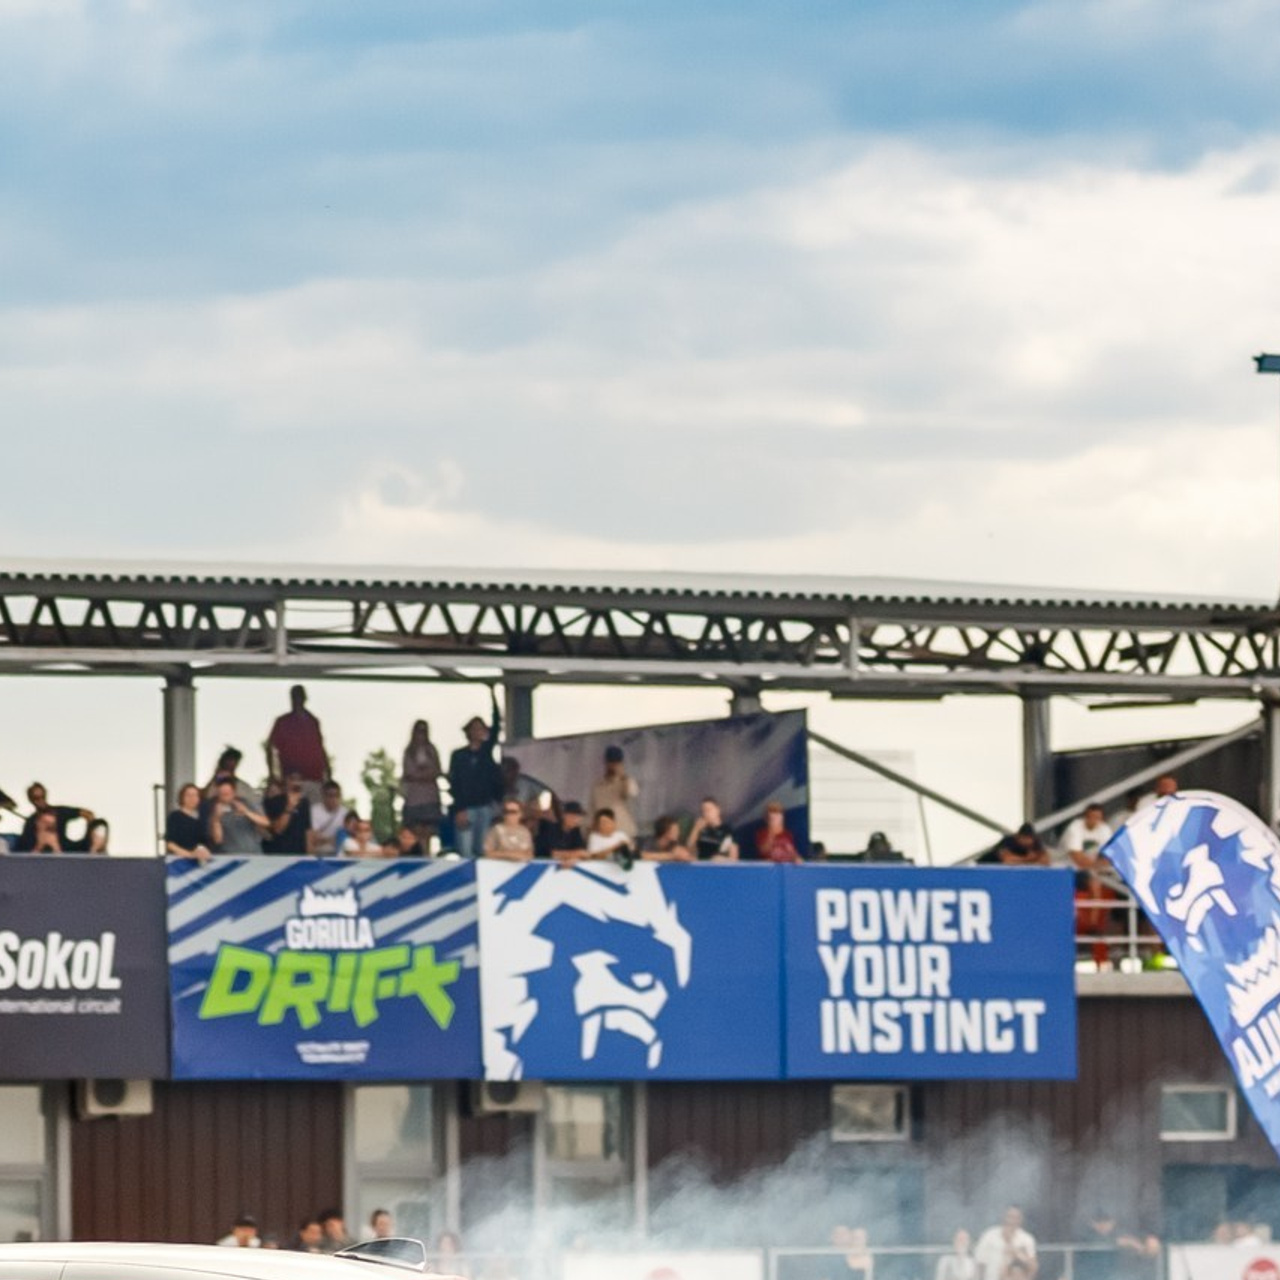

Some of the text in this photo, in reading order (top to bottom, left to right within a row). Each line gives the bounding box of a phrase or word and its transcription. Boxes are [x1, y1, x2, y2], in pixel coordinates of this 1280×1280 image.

[286, 917, 375, 950] GORILLA
[816, 889, 992, 943] POWER
[818, 944, 951, 997] YOUR
[821, 999, 1047, 1054] INSTINCT
